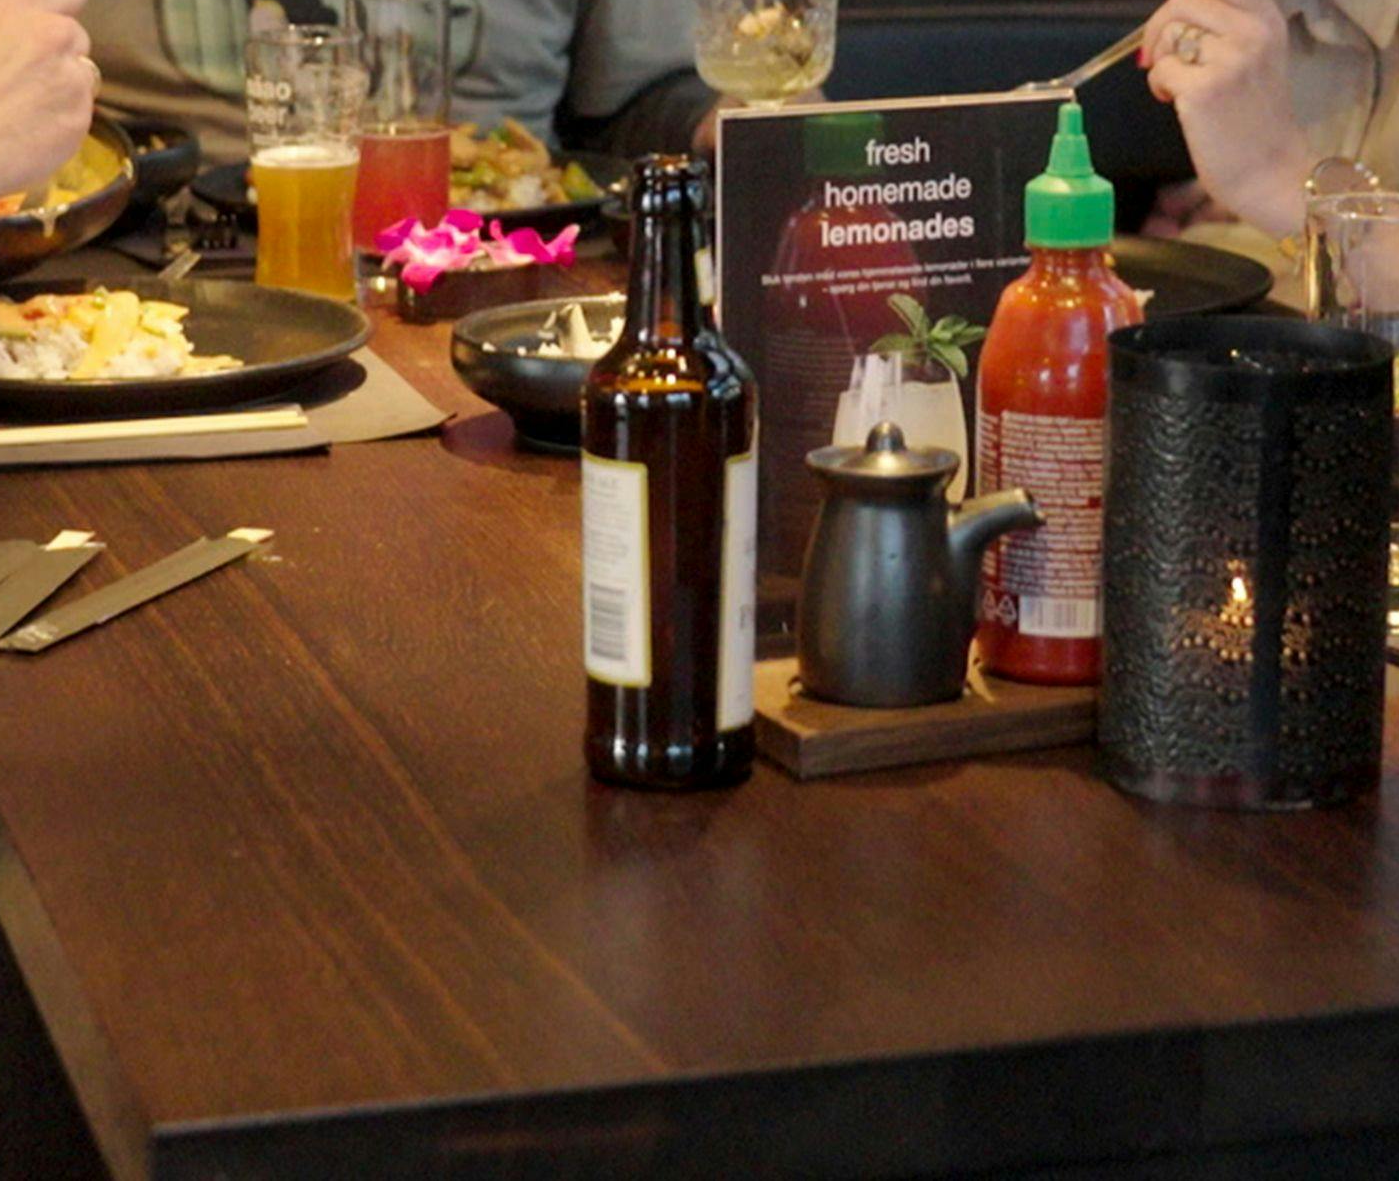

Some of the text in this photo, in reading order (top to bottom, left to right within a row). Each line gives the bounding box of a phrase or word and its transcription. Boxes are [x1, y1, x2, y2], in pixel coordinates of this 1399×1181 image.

[865, 137, 930, 166] fresh
[824, 173, 972, 208] homemade
[820, 212, 974, 248] lemonades
